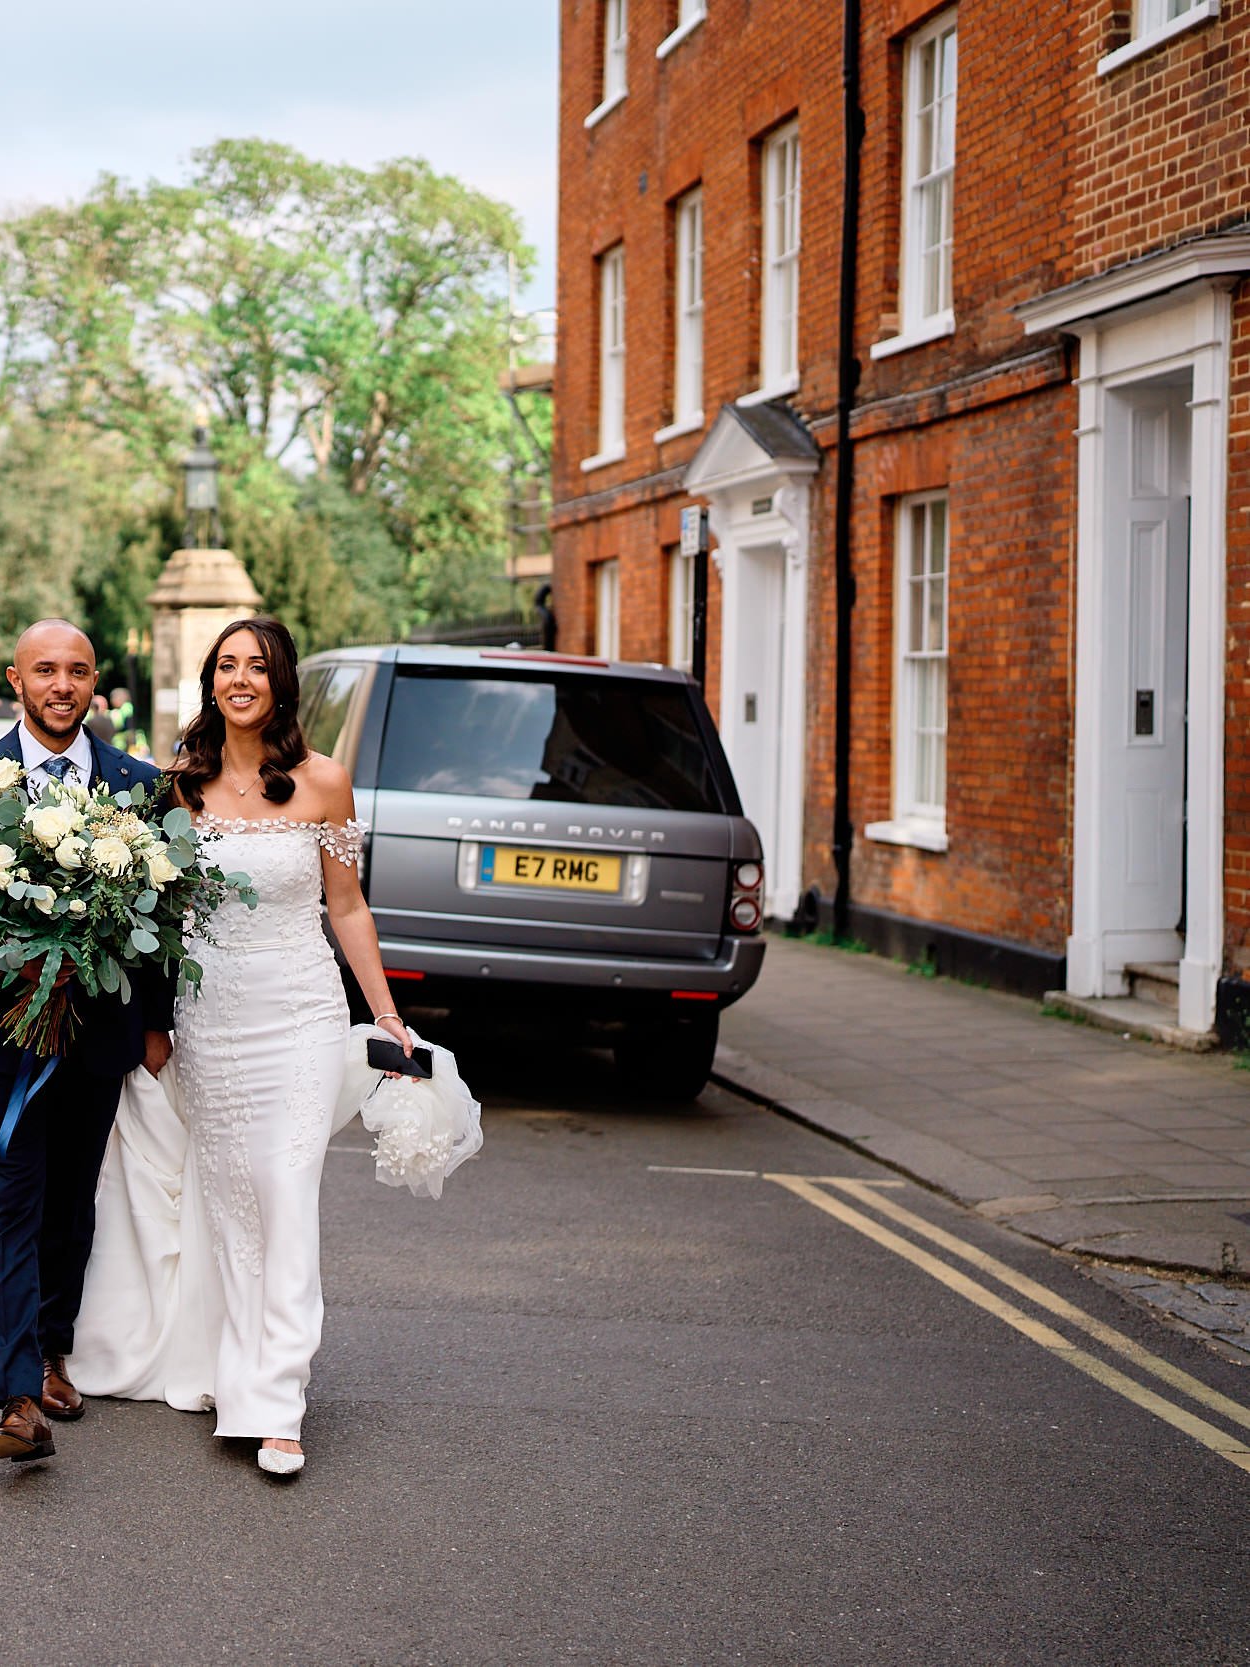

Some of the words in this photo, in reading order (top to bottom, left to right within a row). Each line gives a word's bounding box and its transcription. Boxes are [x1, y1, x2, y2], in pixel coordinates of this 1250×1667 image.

[447, 816, 547, 833] RANGE
[567, 824, 665, 842] ROVER
[515, 855, 545, 878] E7
[552, 858, 598, 882] RMG
